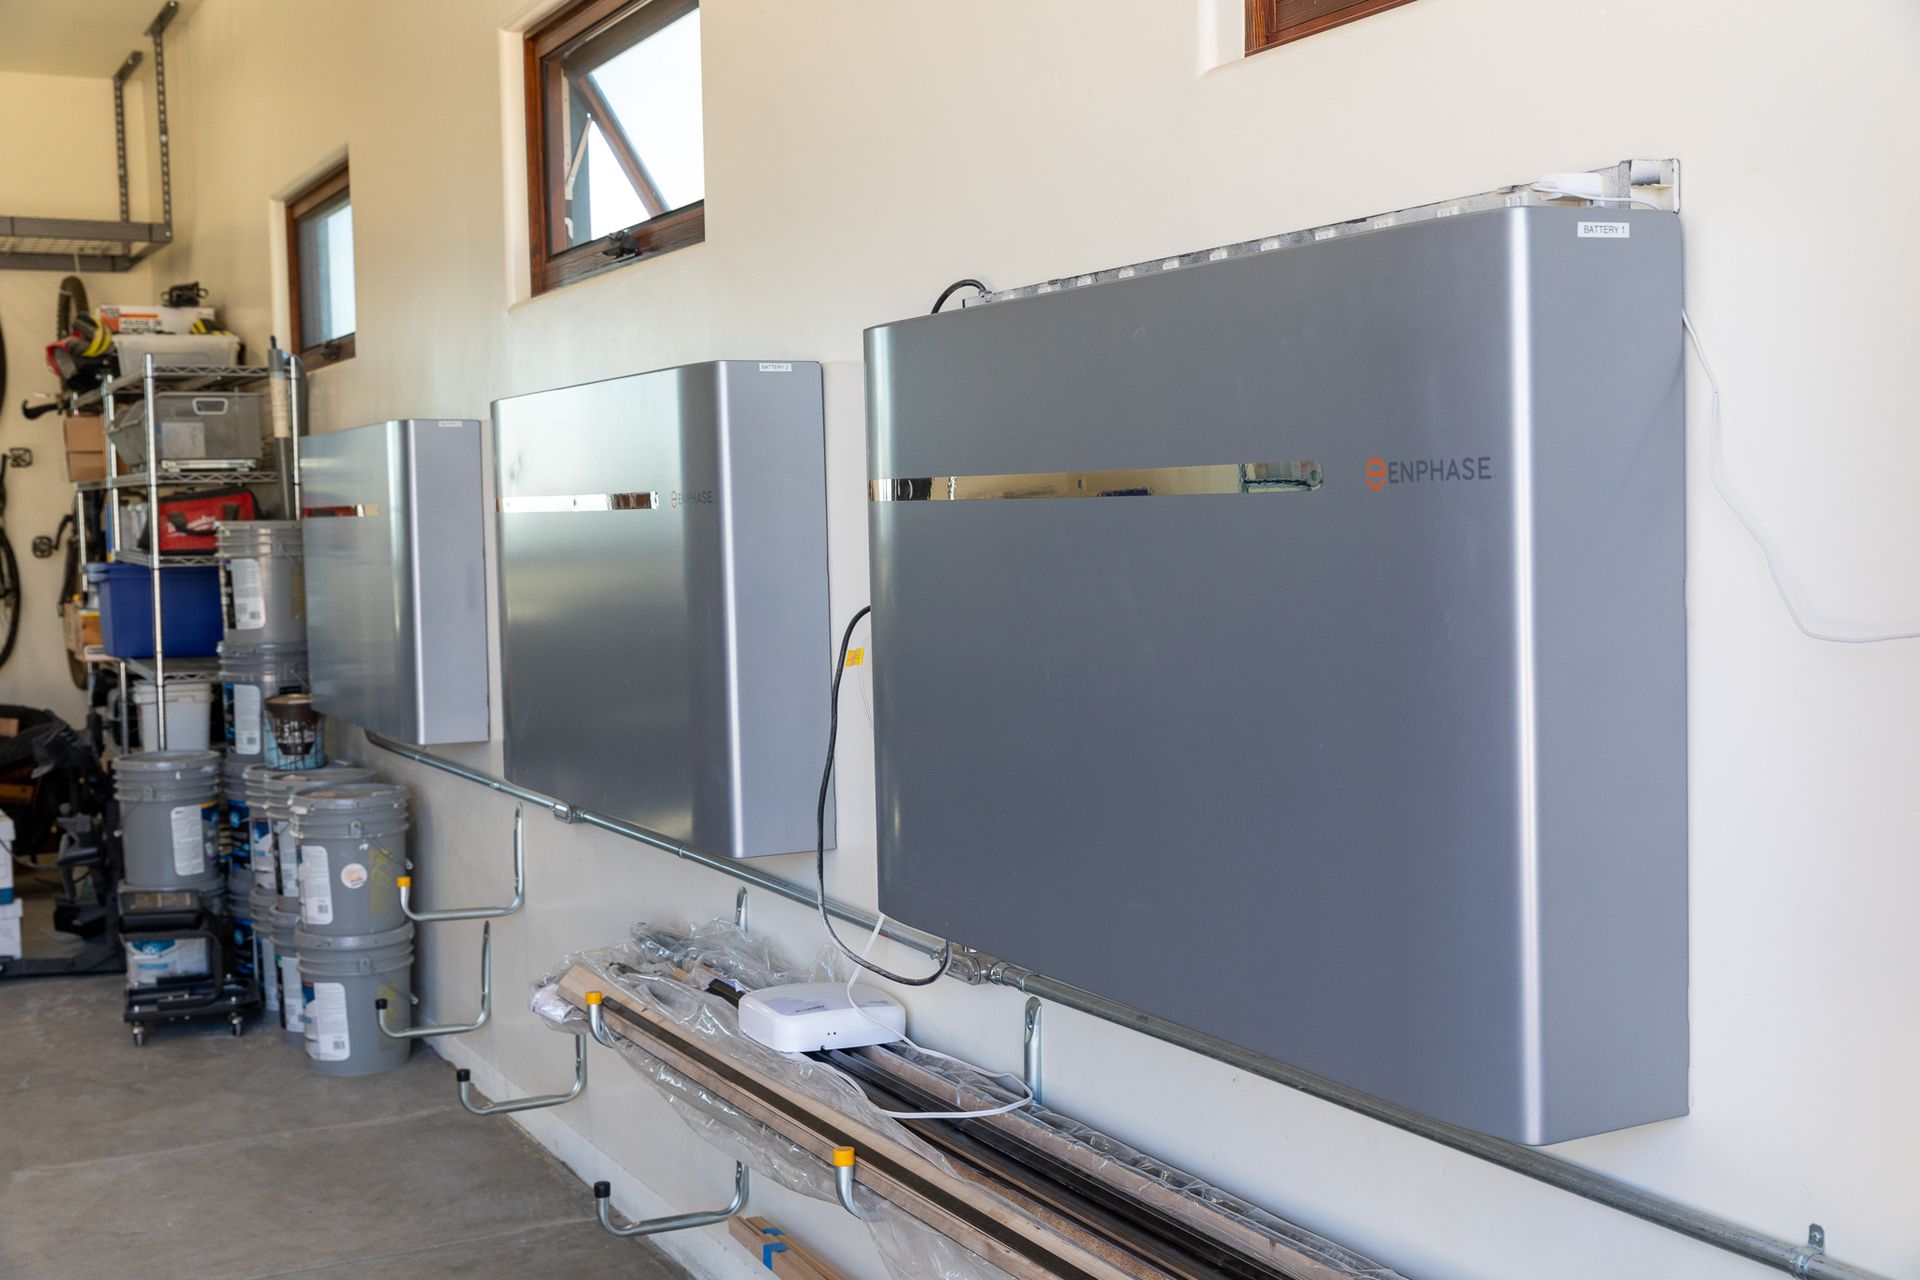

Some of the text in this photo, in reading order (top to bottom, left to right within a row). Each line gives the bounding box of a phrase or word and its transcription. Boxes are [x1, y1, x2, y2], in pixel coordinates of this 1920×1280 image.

[1583, 225, 1619, 234] BATTERY
[1388, 456, 1492, 484] ENPHASE
[678, 490, 713, 505] EPHASE
